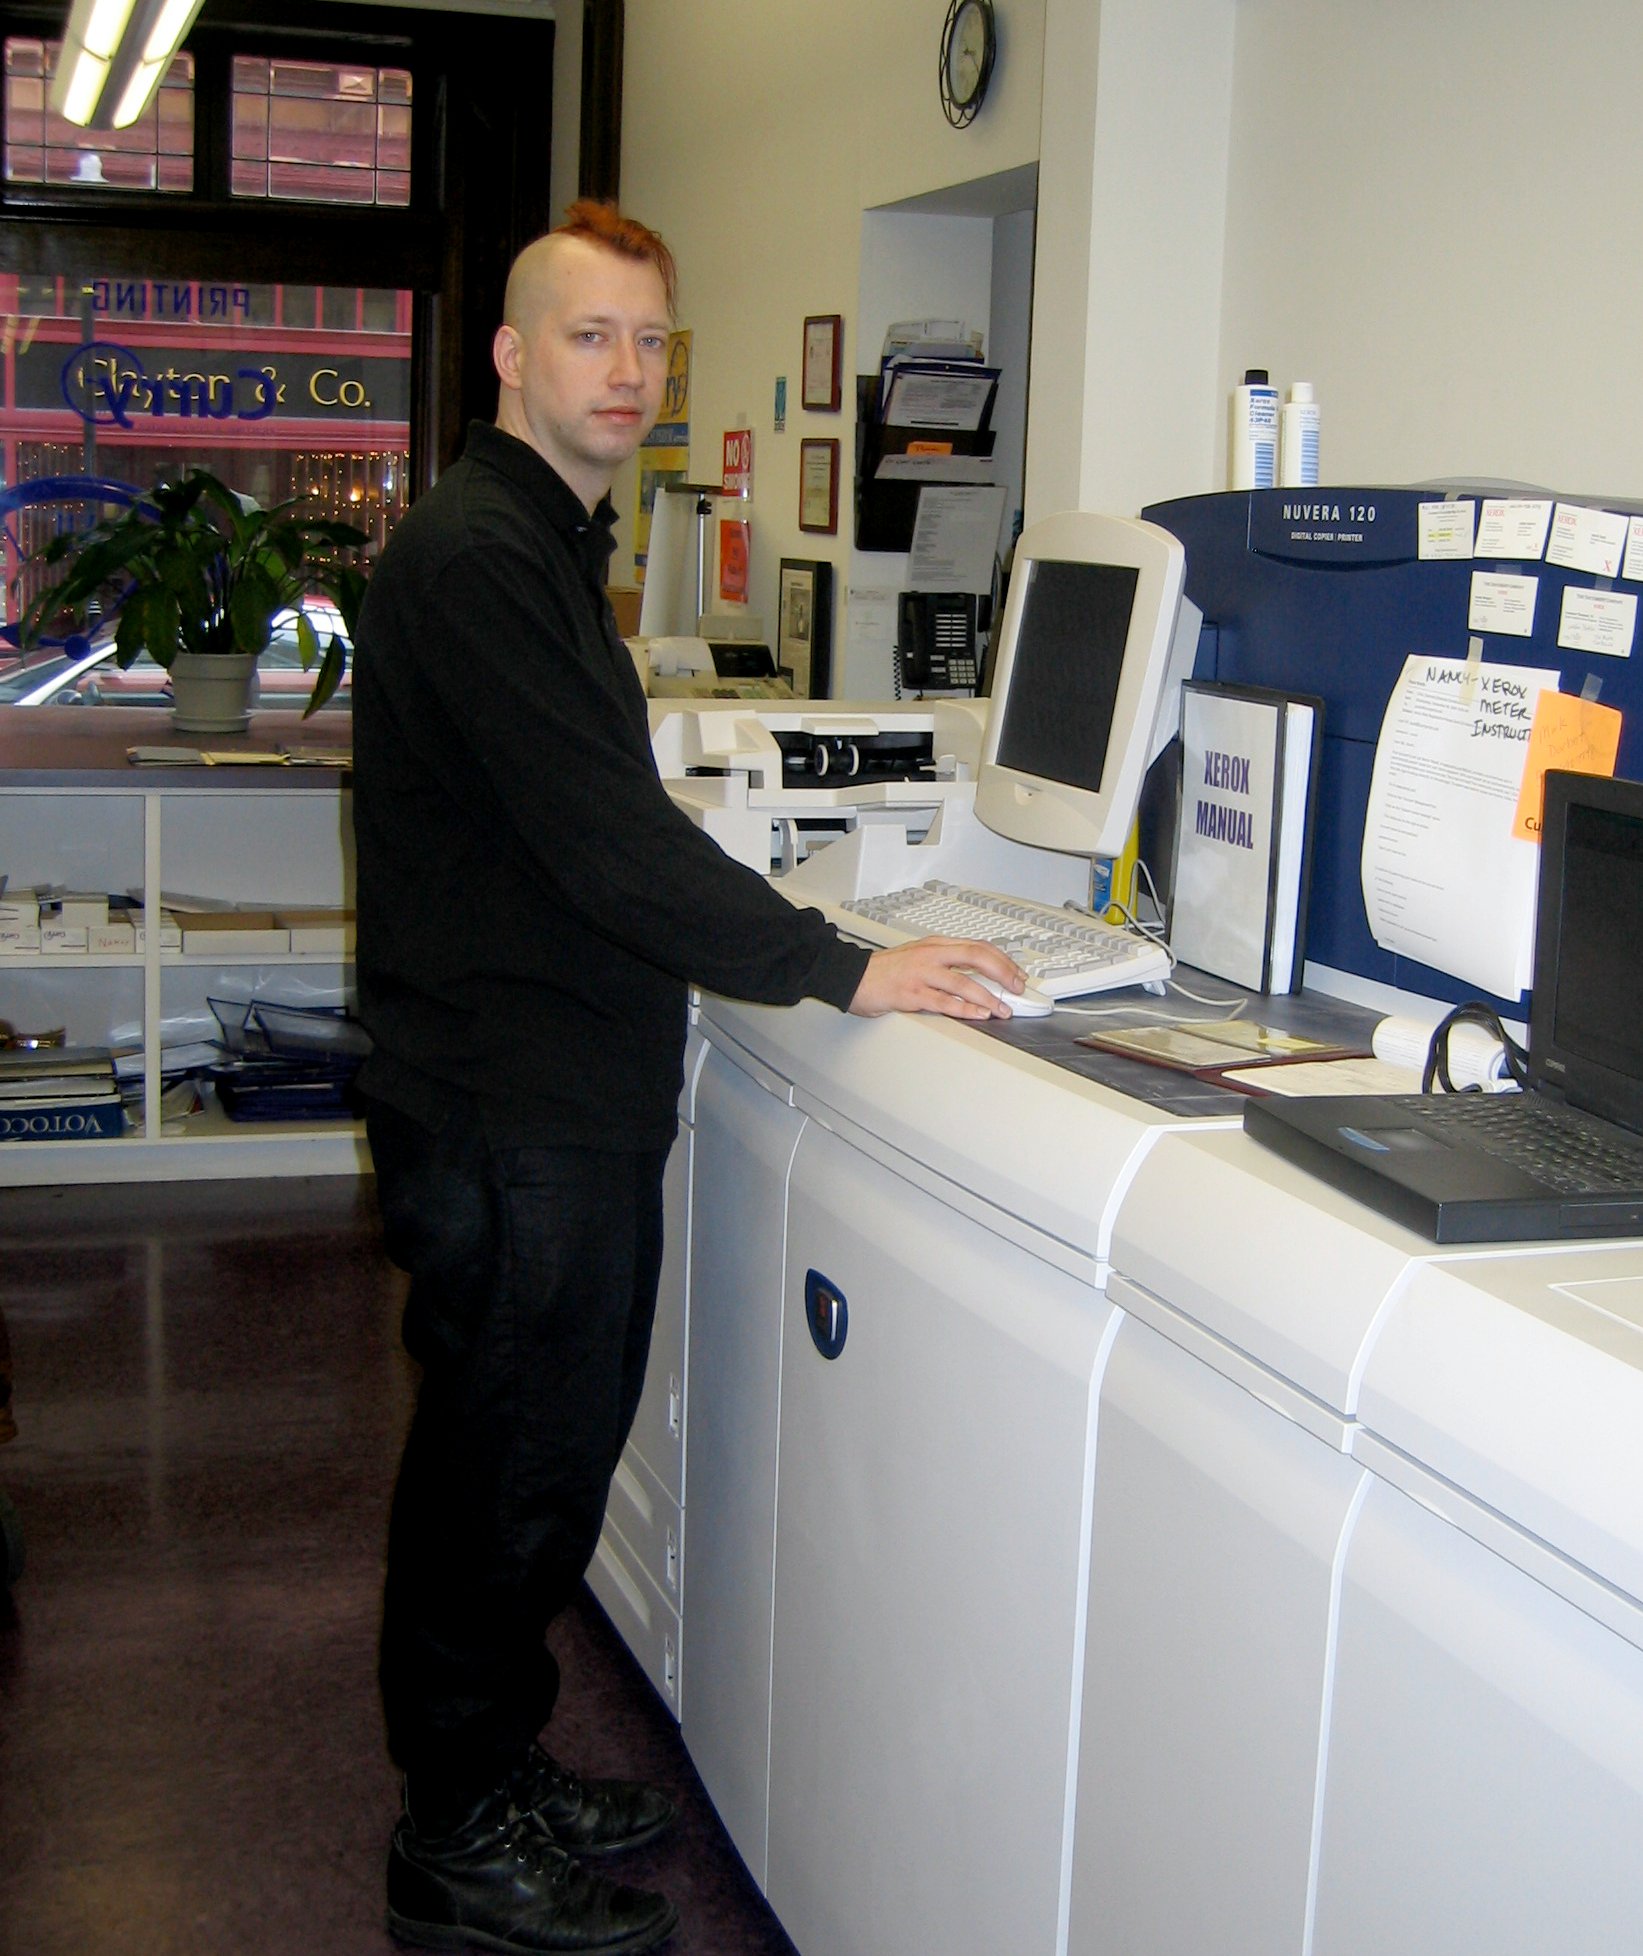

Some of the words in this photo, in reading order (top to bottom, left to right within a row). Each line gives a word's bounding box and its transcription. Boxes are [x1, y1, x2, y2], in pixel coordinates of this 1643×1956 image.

[77, 357, 231, 409] Clayton
[309, 368, 371, 407] Co.
[726, 439, 740, 467] NO
[1282, 504, 1340, 521] NUVERA
[1349, 506, 1376, 522] 120
[1481, 676, 1528, 699] XEROX
[1480, 698, 1531, 720] METER
[1203, 750, 1250, 795] XEROX
[1195, 800, 1254, 850] MANUAL
[1524, 816, 1541, 832] Cu
